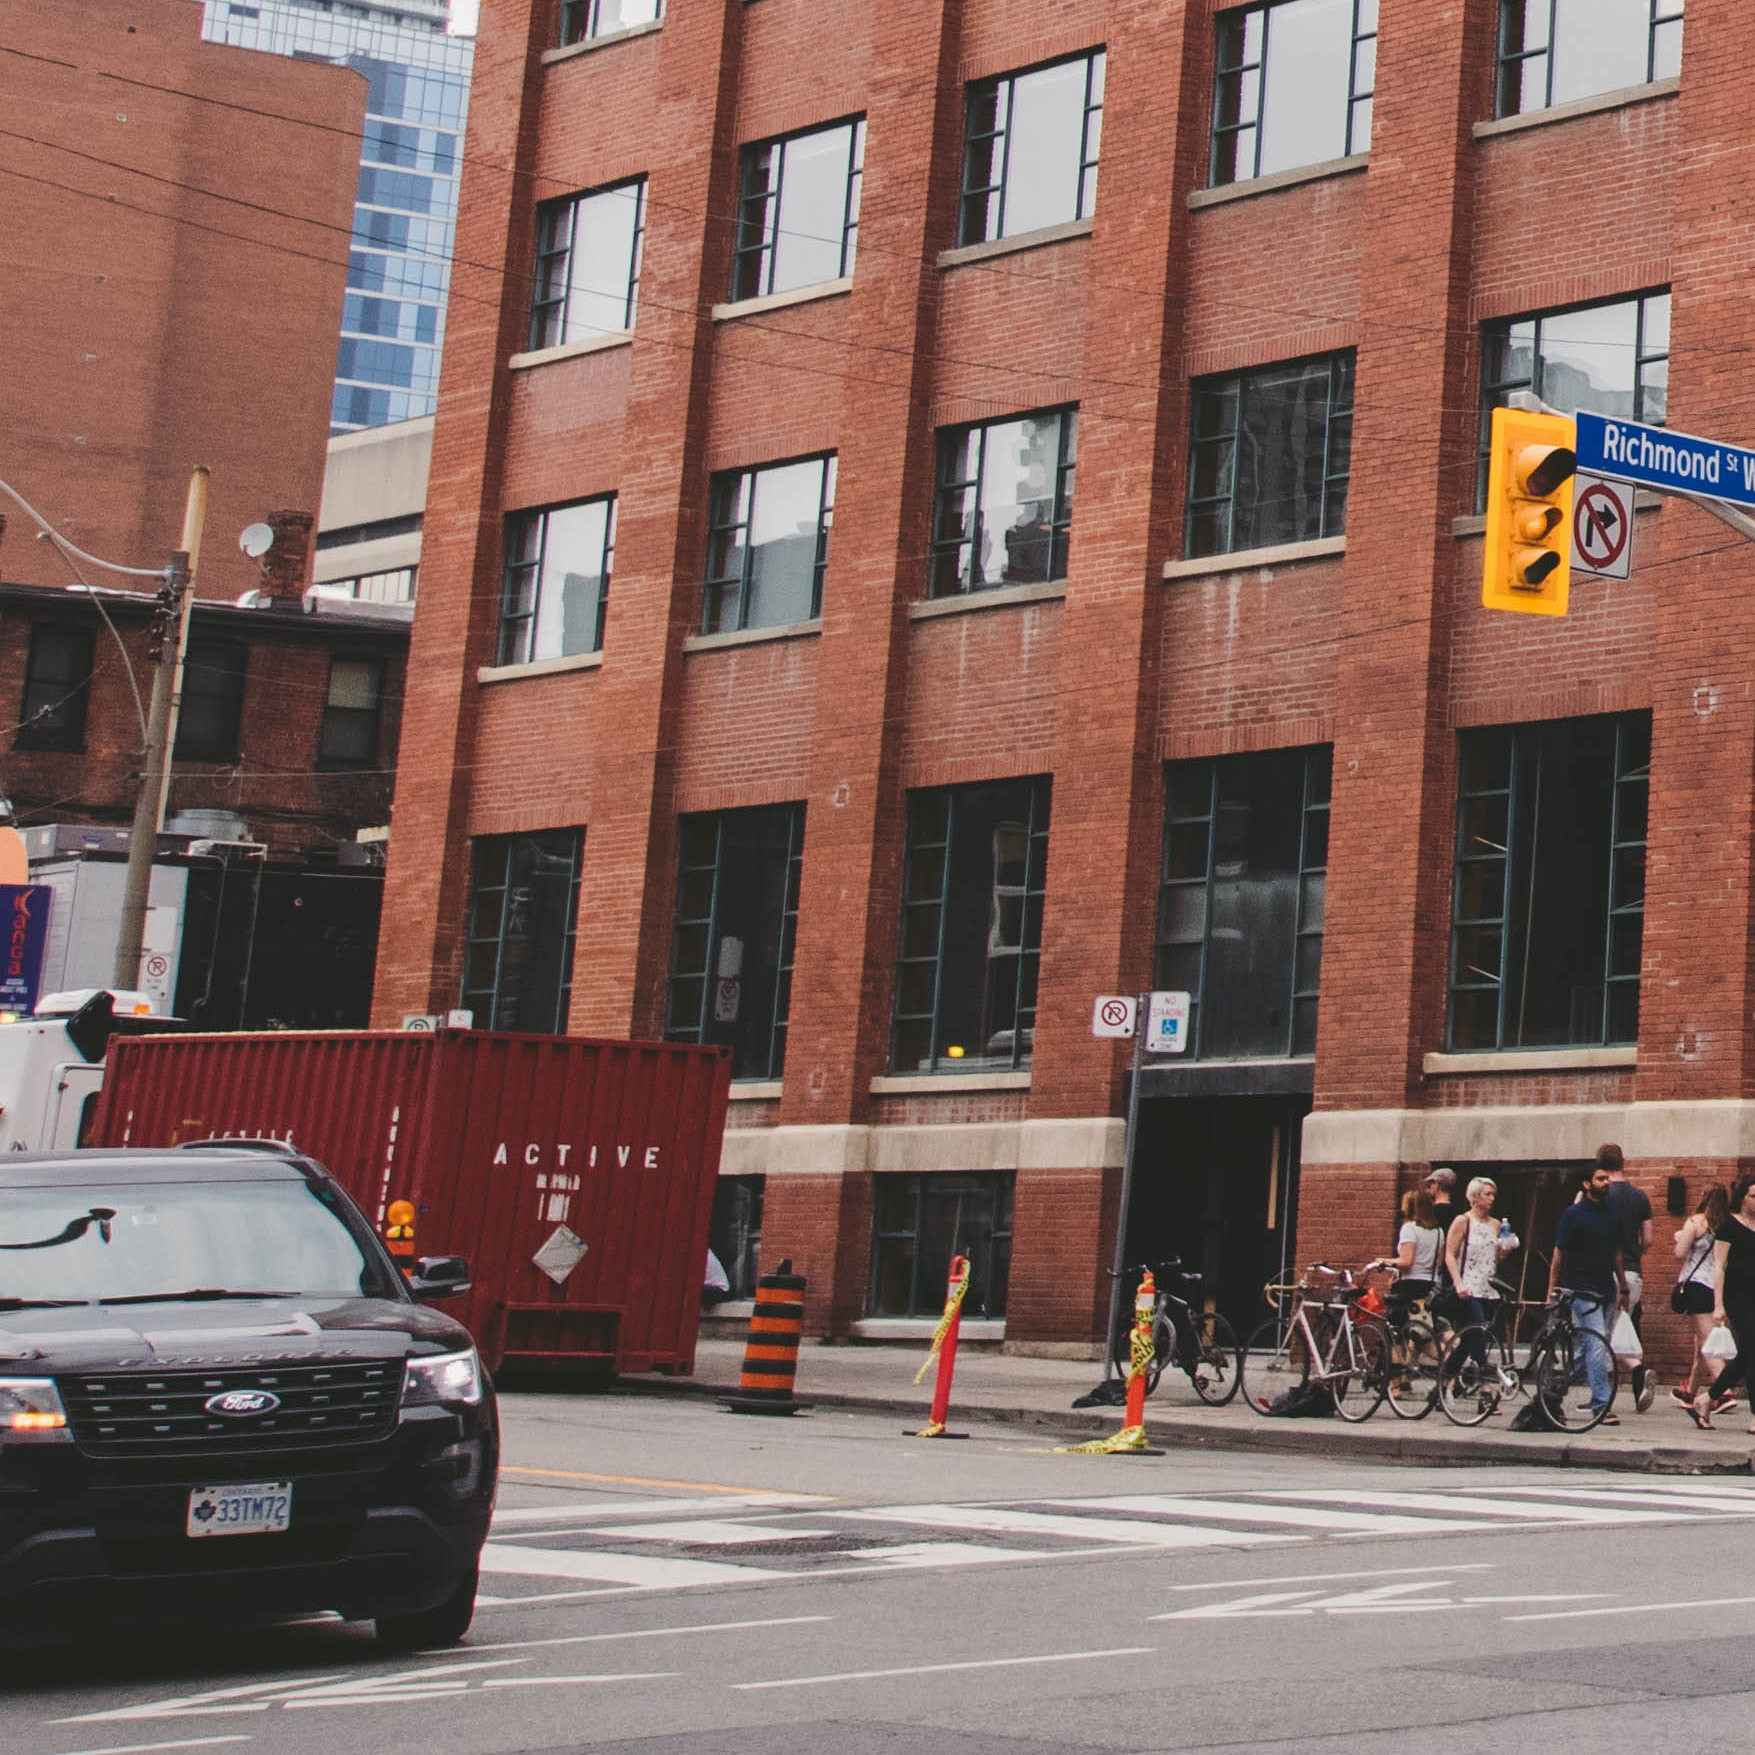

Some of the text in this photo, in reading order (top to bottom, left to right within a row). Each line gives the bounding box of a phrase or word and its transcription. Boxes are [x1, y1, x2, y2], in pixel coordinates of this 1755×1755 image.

[1603, 424, 1720, 484] Richmond
[1726, 453, 1739, 472] St
[493, 1143, 660, 1168] ACTIVE
[220, 1394, 265, 1410] Ford
[216, 1496, 287, 1523] 33TM72
